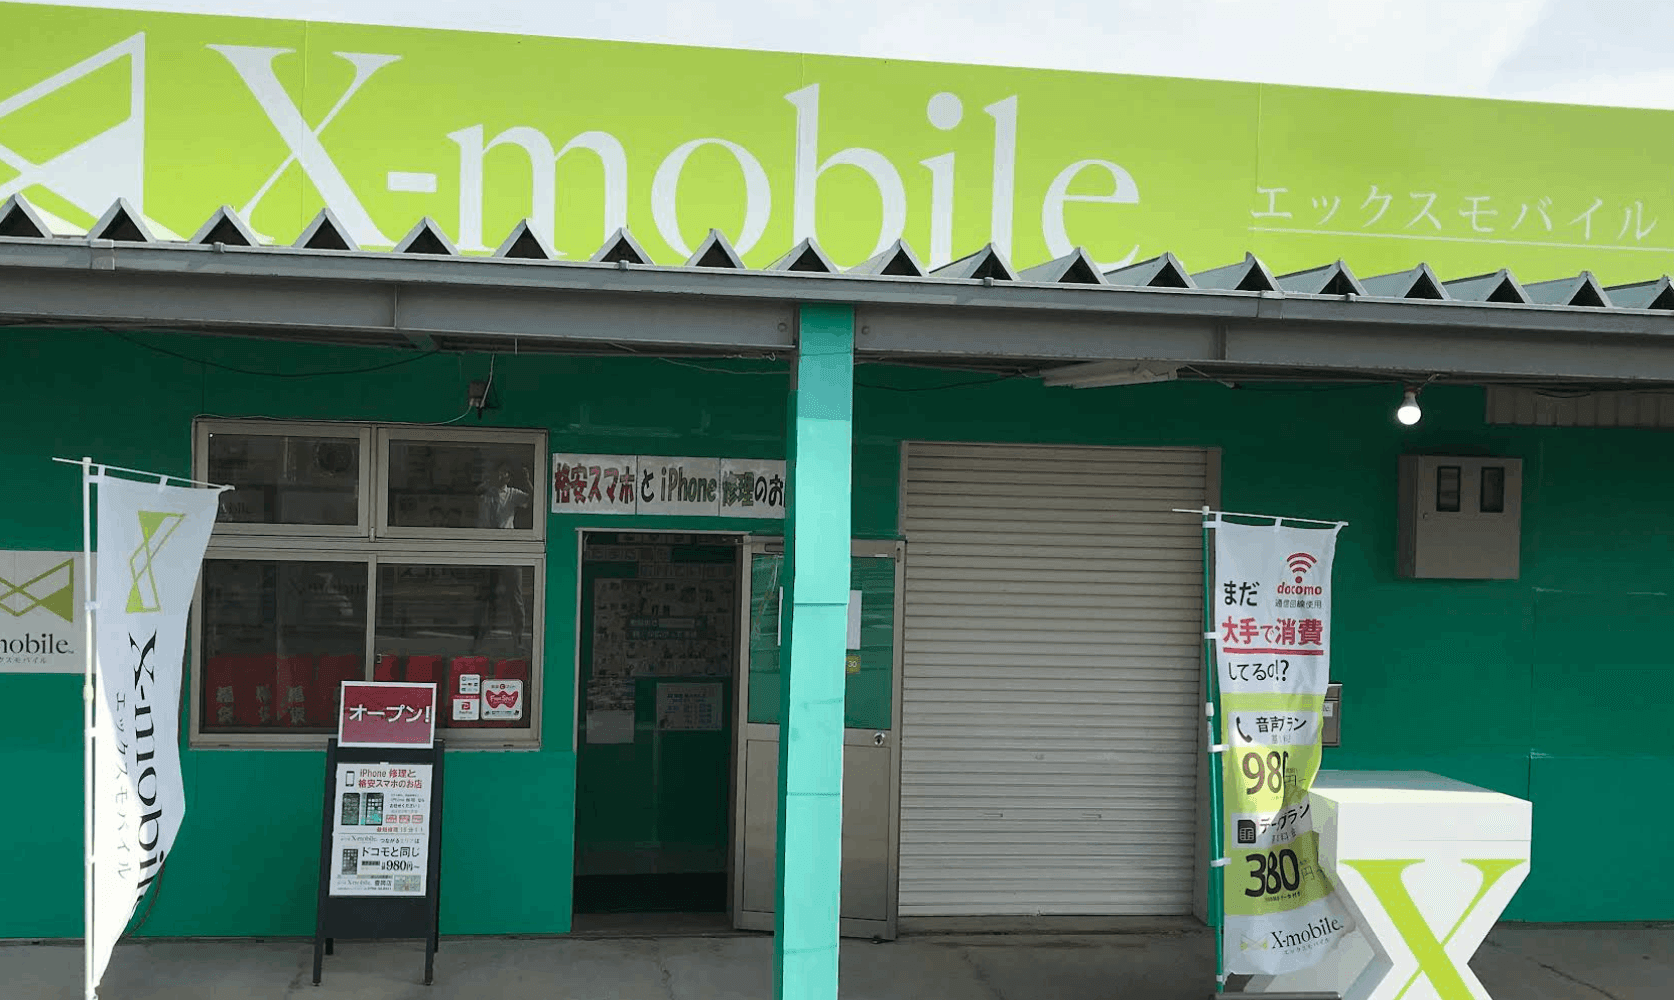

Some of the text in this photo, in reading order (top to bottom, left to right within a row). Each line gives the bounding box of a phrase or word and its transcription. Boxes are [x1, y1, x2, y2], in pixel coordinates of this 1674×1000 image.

[205, 43, 1141, 270] X-mobile
[1250, 185, 1658, 241] エックスモバイル
[1223, 580, 1260, 606] まだ
[1277, 581, 1323, 595] docomo
[1222, 615, 1323, 646] 大手で消費
[349, 703, 431, 724] オープン!
[360, 768, 387, 778] iPhone
[362, 846, 420, 858] ドコモと同じ
[1270, 916, 1341, 950] X-mobile
[1338, 858, 1528, 1000] X
